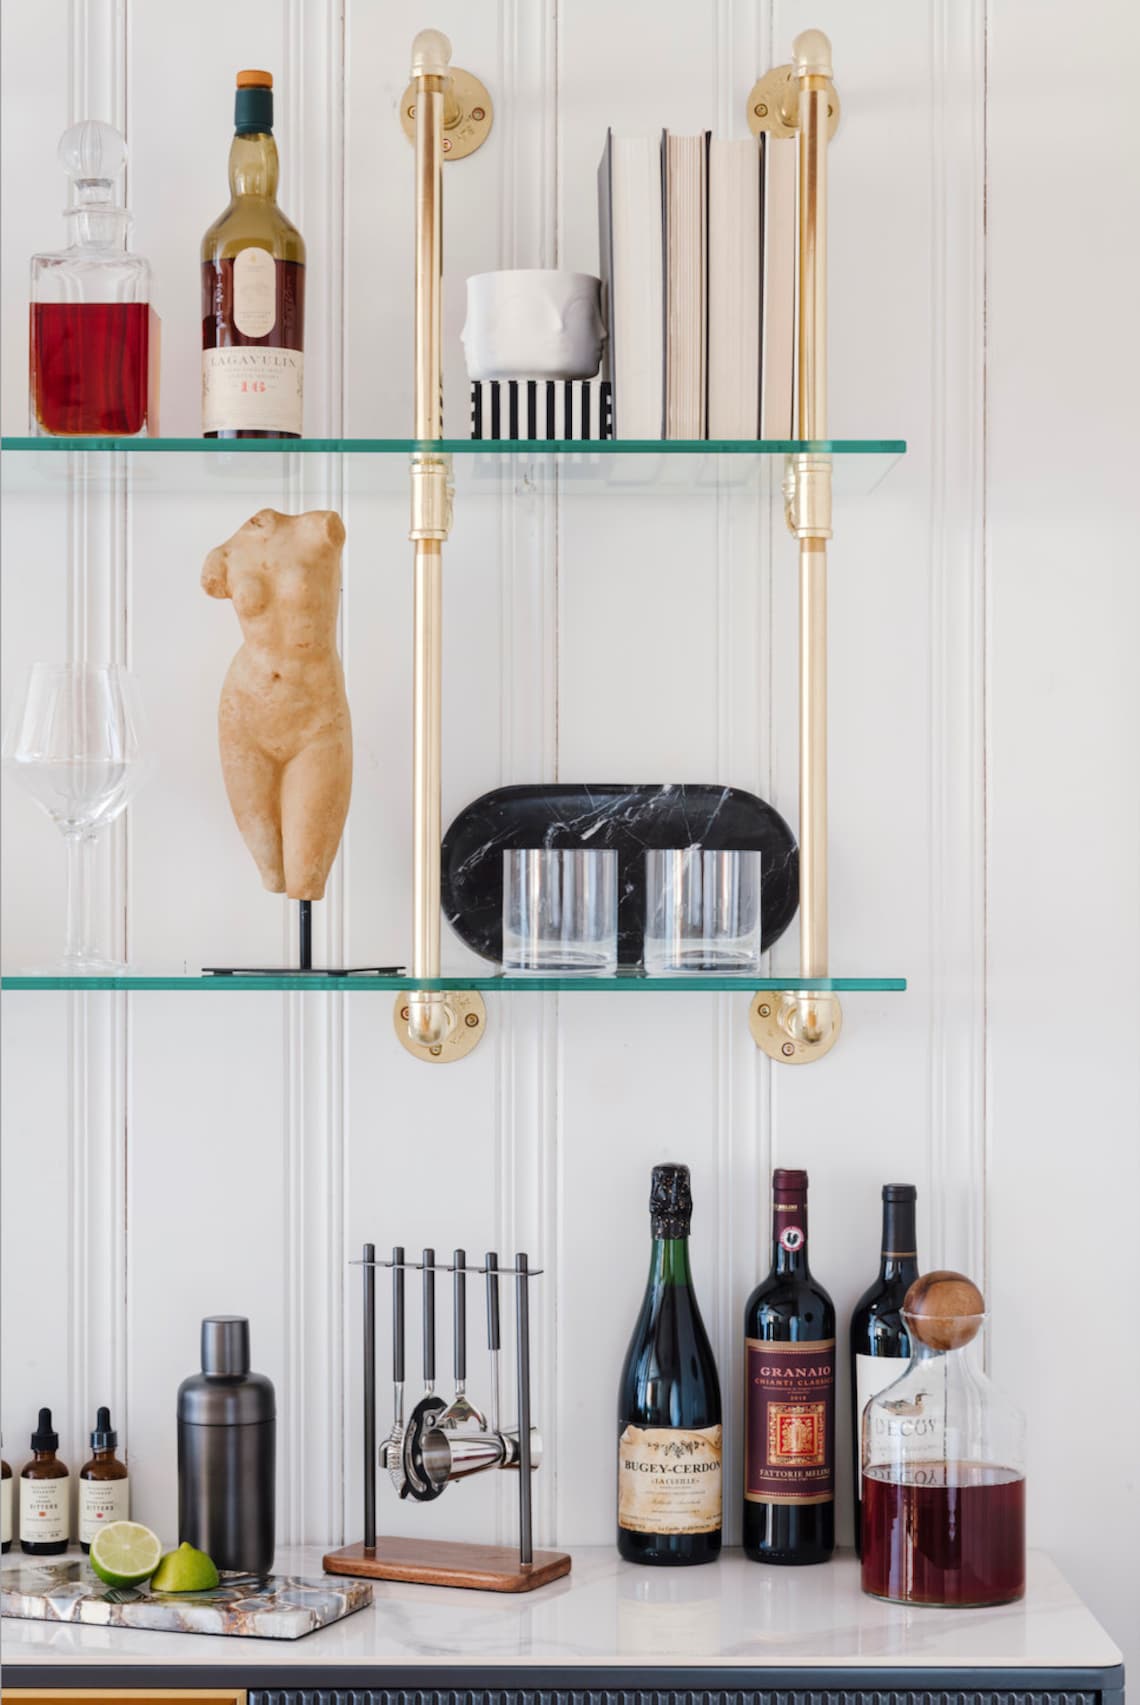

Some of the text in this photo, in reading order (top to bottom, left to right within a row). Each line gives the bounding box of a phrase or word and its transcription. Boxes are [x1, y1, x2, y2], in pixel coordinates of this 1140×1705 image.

[209, 355, 297, 368] LAGAVULIN
[241, 380, 267, 393] 16
[760, 1366, 831, 1377] GRANAIO
[754, 1377, 793, 1386] CHIANTI
[875, 1417, 936, 1437] DECOY
[624, 1460, 720, 1474] BUGEY-CERDON
[760, 1468, 803, 1478] FATTORIE
